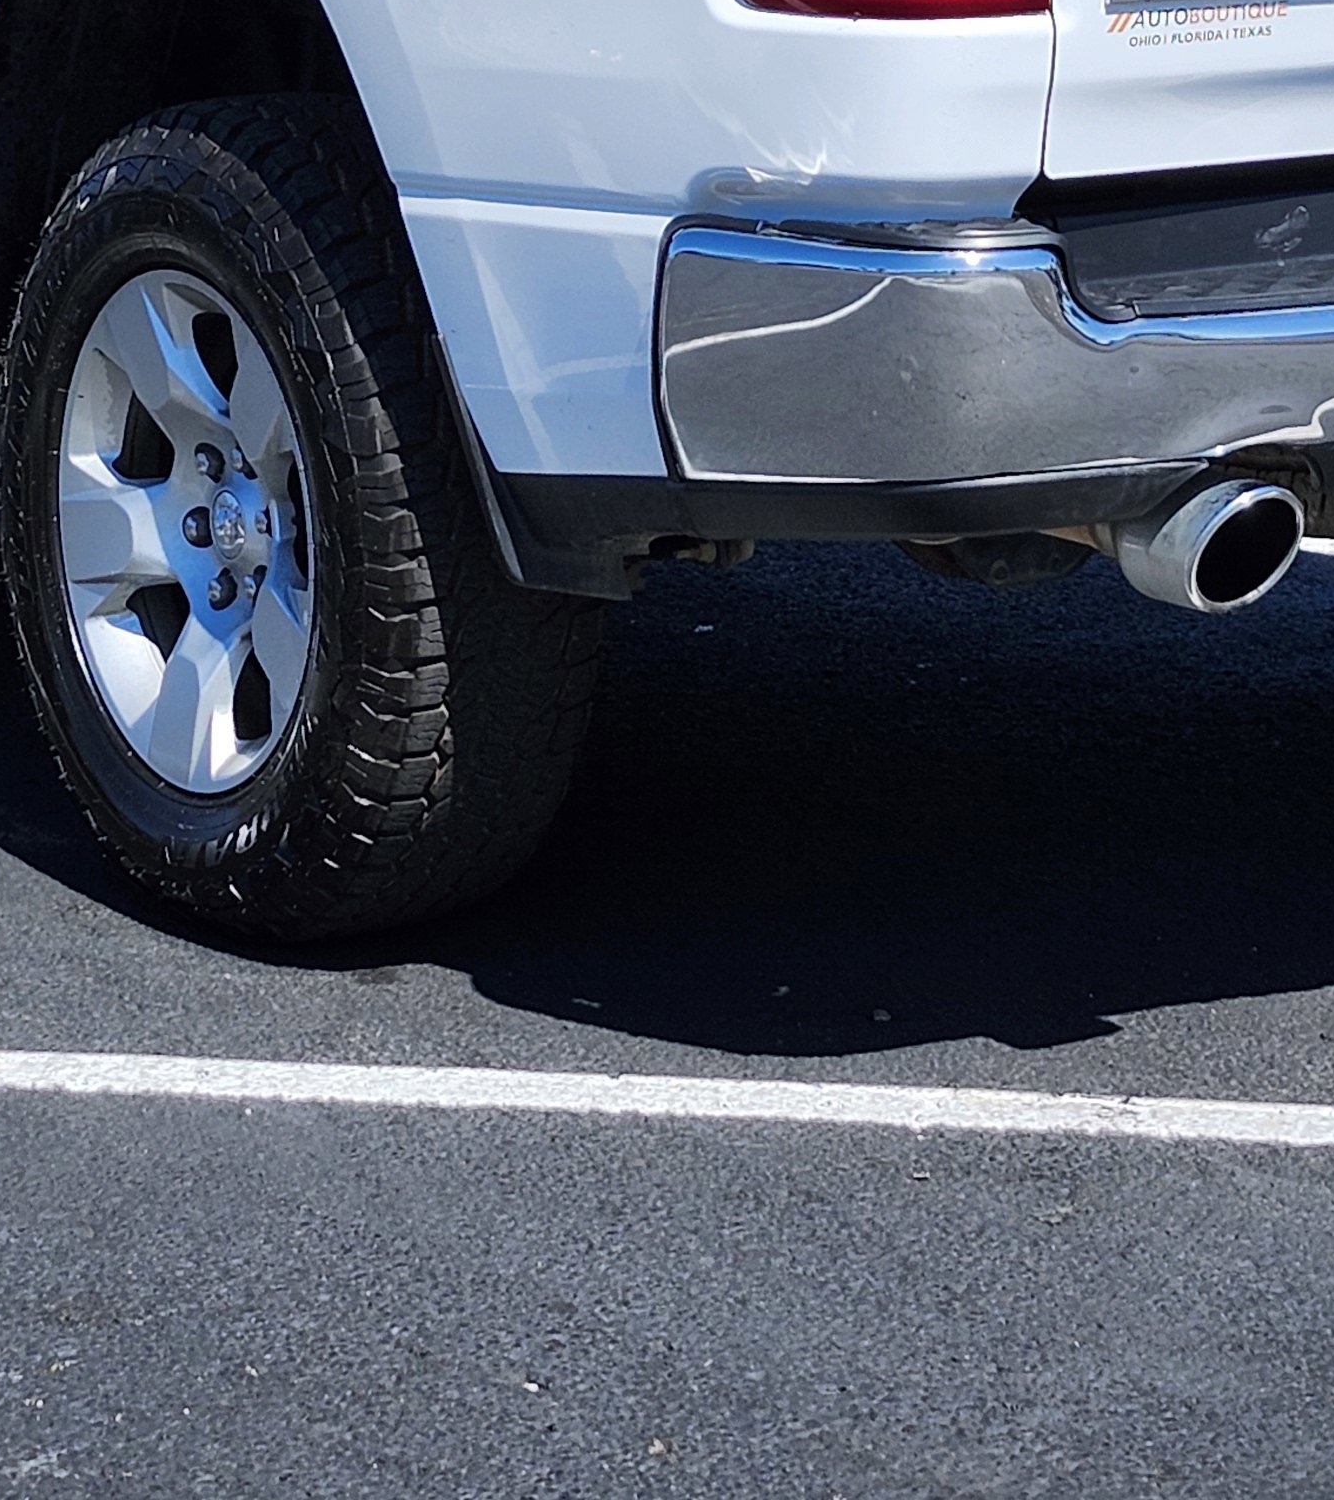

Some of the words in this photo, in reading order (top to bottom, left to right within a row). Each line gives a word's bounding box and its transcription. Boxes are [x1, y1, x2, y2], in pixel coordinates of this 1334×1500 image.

[1129, 36, 1161, 47] OHIO
[1171, 30, 1223, 44] FLORIDA
[1233, 26, 1272, 39] TEXAS
